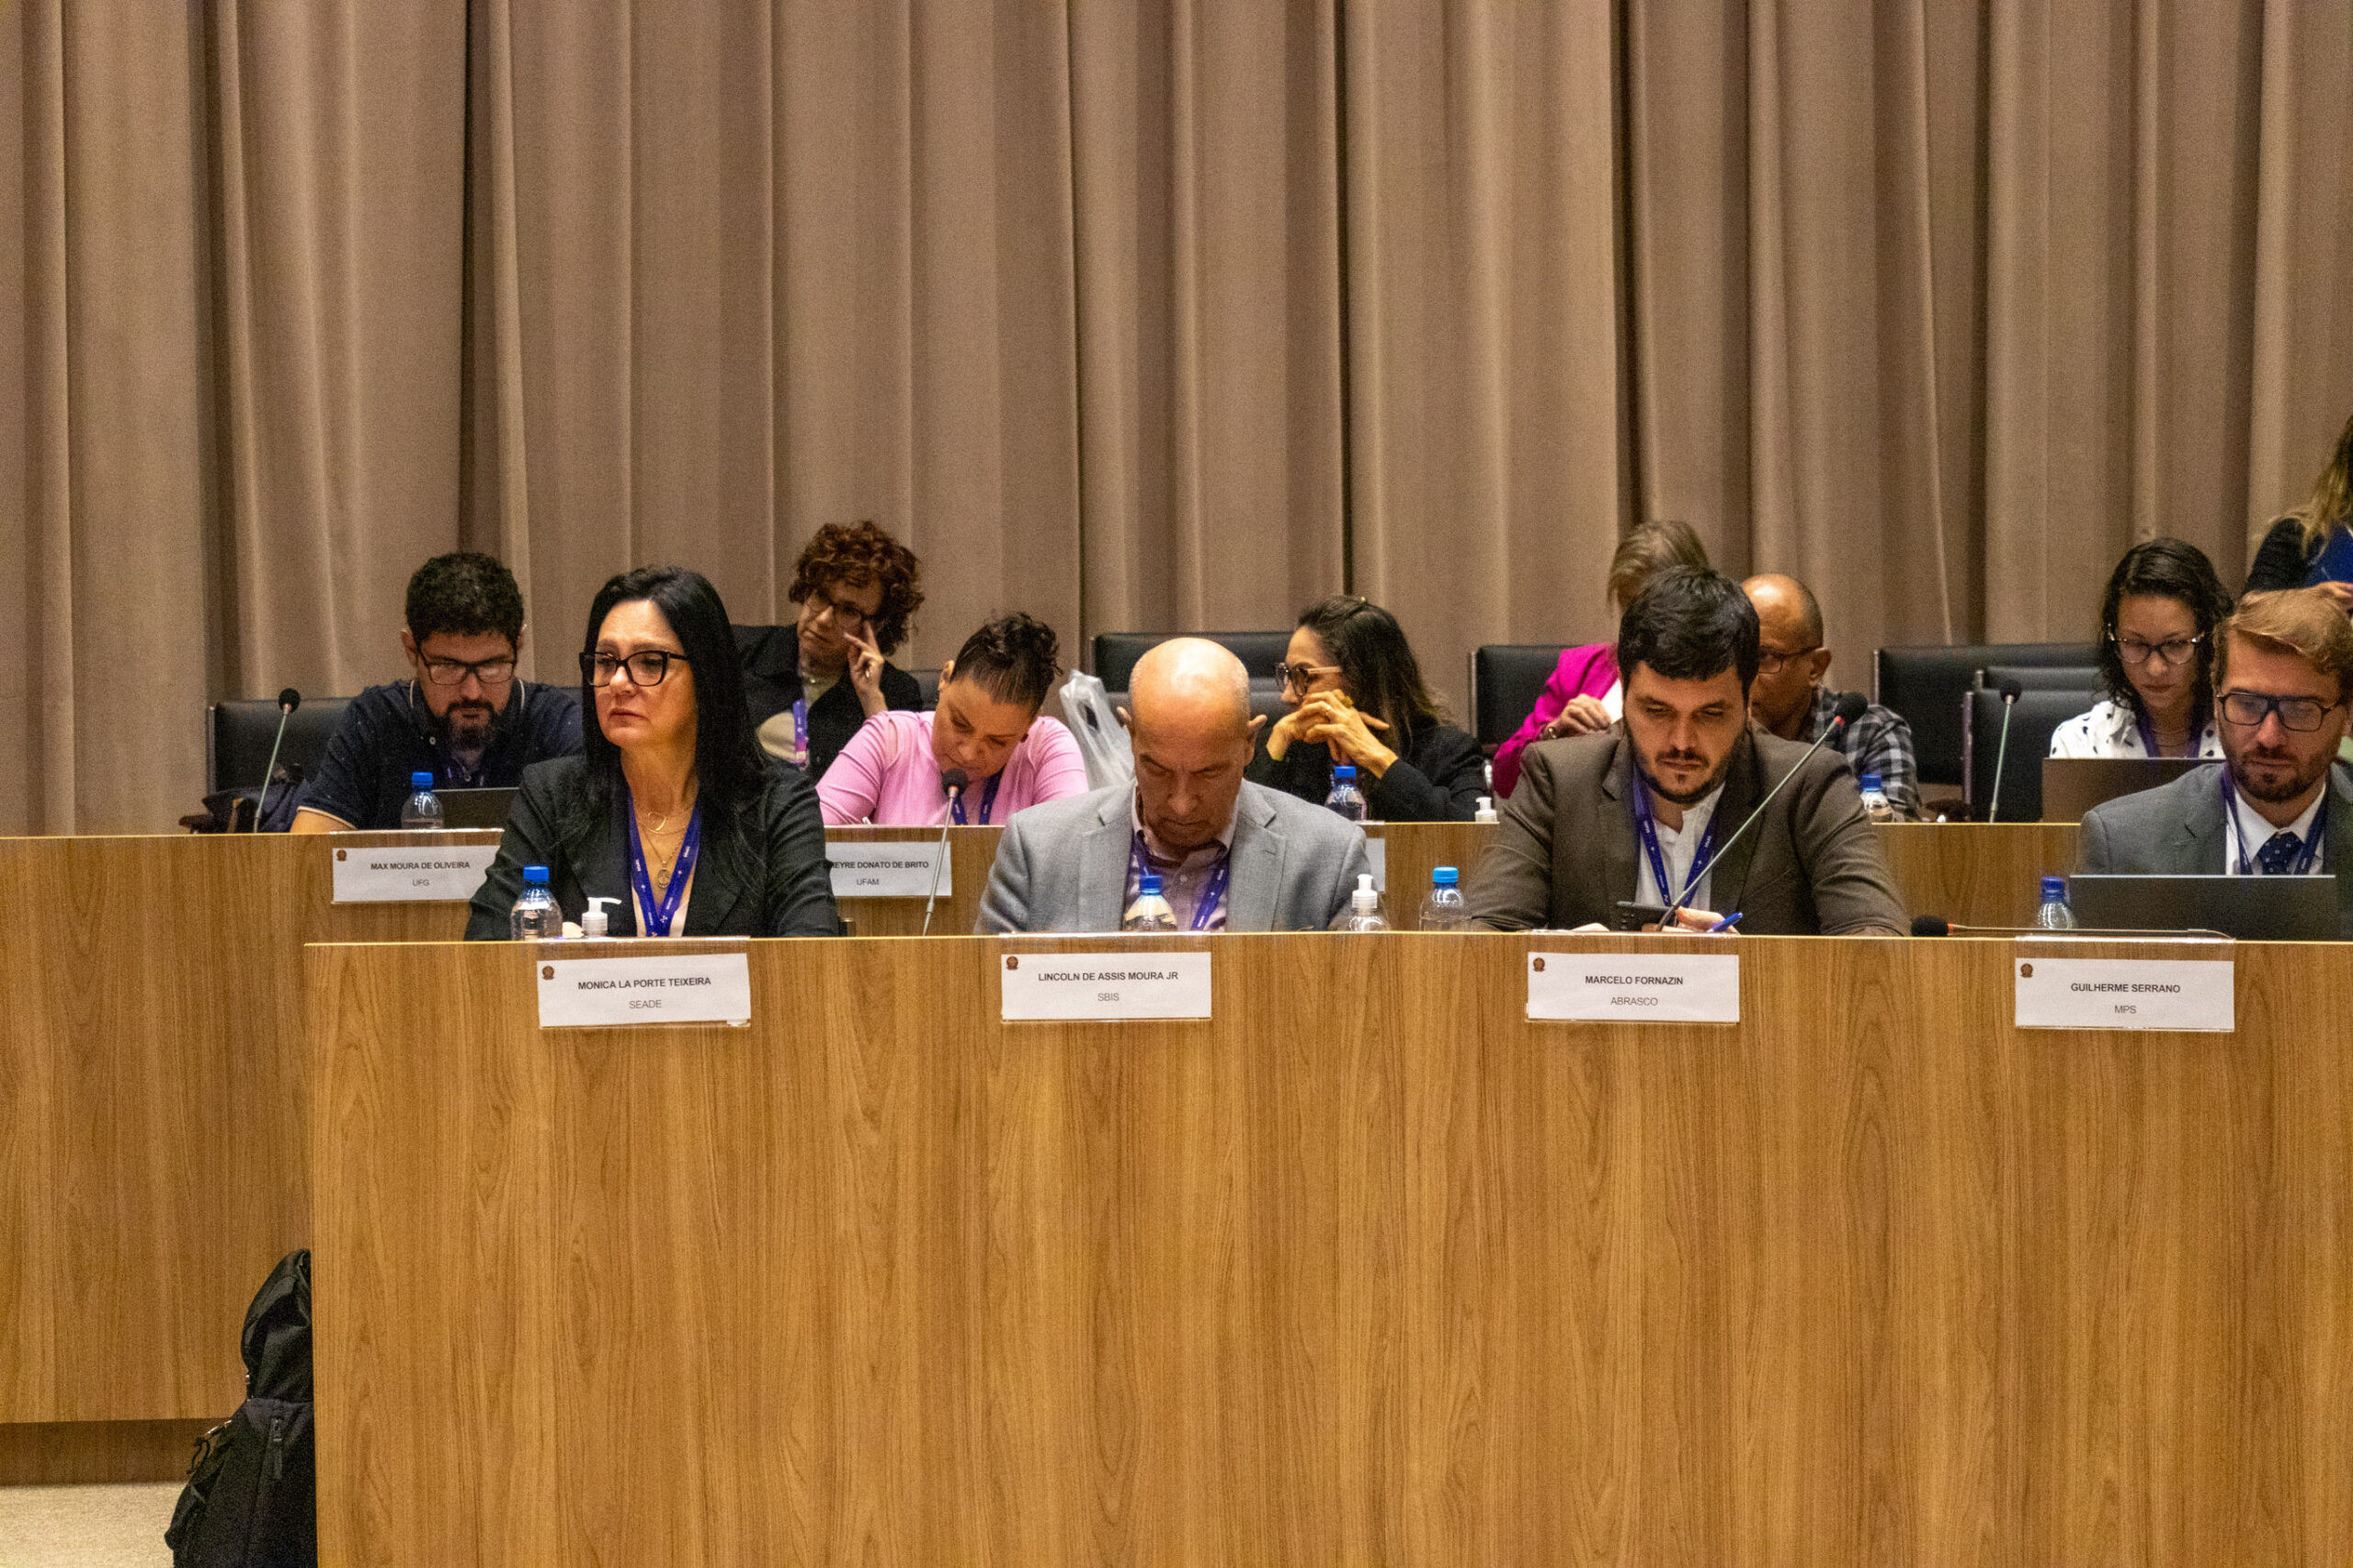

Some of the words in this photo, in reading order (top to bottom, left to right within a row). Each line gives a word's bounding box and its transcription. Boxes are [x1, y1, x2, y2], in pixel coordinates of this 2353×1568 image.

[857, 878, 880, 886] UFAM
[1083, 972, 1095, 981] DE
[1097, 972, 1126, 981] ASSIS
[1129, 971, 1164, 980] MOURA
[1166, 971, 1178, 980] JR
[1586, 976, 1632, 984] MARCELO
[578, 981, 616, 989] MONICA
[633, 979, 665, 987] PORTE
[668, 977, 711, 986] TEIXEIRA
[2071, 983, 2129, 992] GUILHERME
[2131, 984, 2180, 993] SERRANO
[1098, 993, 1120, 1001] SBIS
[1610, 997, 1658, 1006] ABRASCO
[630, 1000, 662, 1009] SEADE
[2115, 1006, 2136, 1014] MPS
